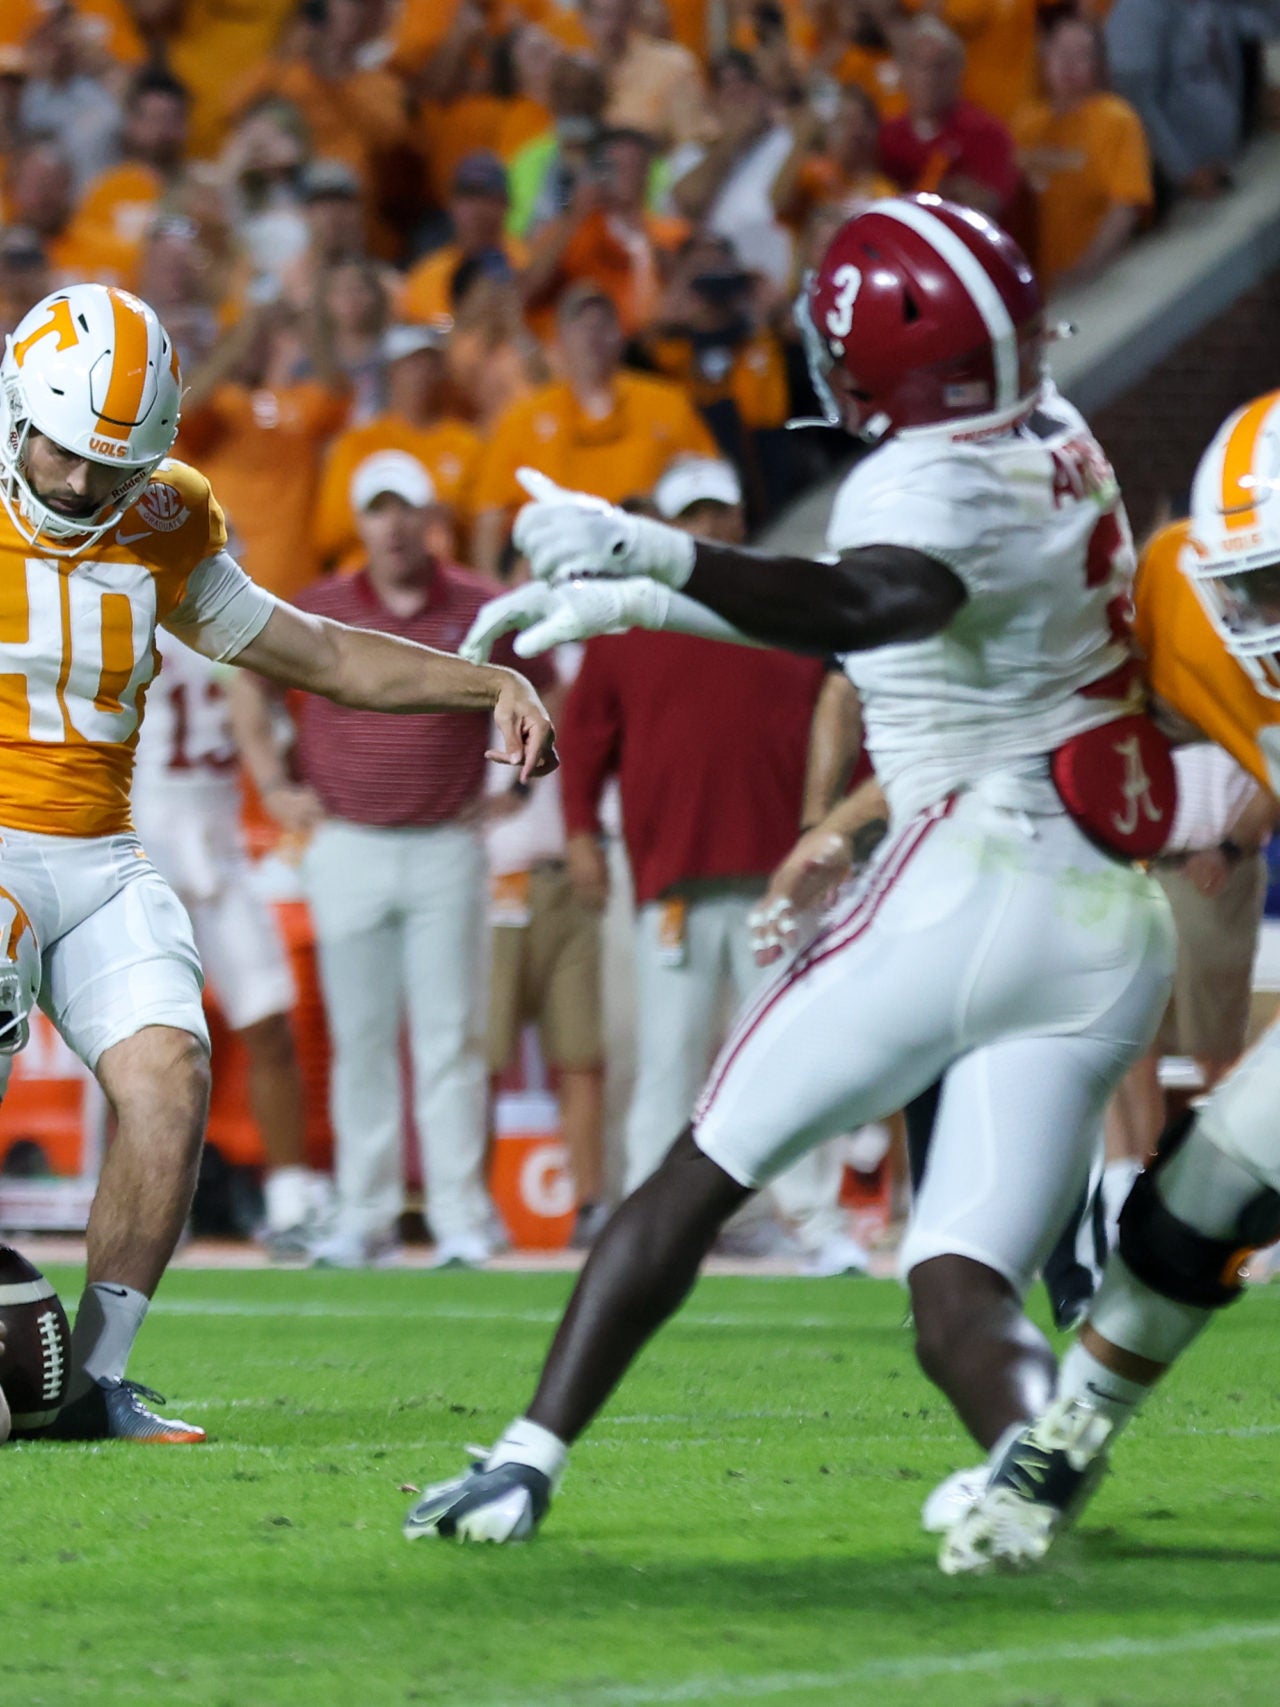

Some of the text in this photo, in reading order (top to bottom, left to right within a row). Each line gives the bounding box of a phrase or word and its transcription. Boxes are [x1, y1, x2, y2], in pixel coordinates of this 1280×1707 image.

[826, 264, 862, 337] 3
[13, 299, 79, 368] T
[89, 437, 128, 458] VOLS
[144, 483, 180, 518] SEC
[1221, 533, 1263, 552] VOS
[520, 1143, 576, 1218] G
